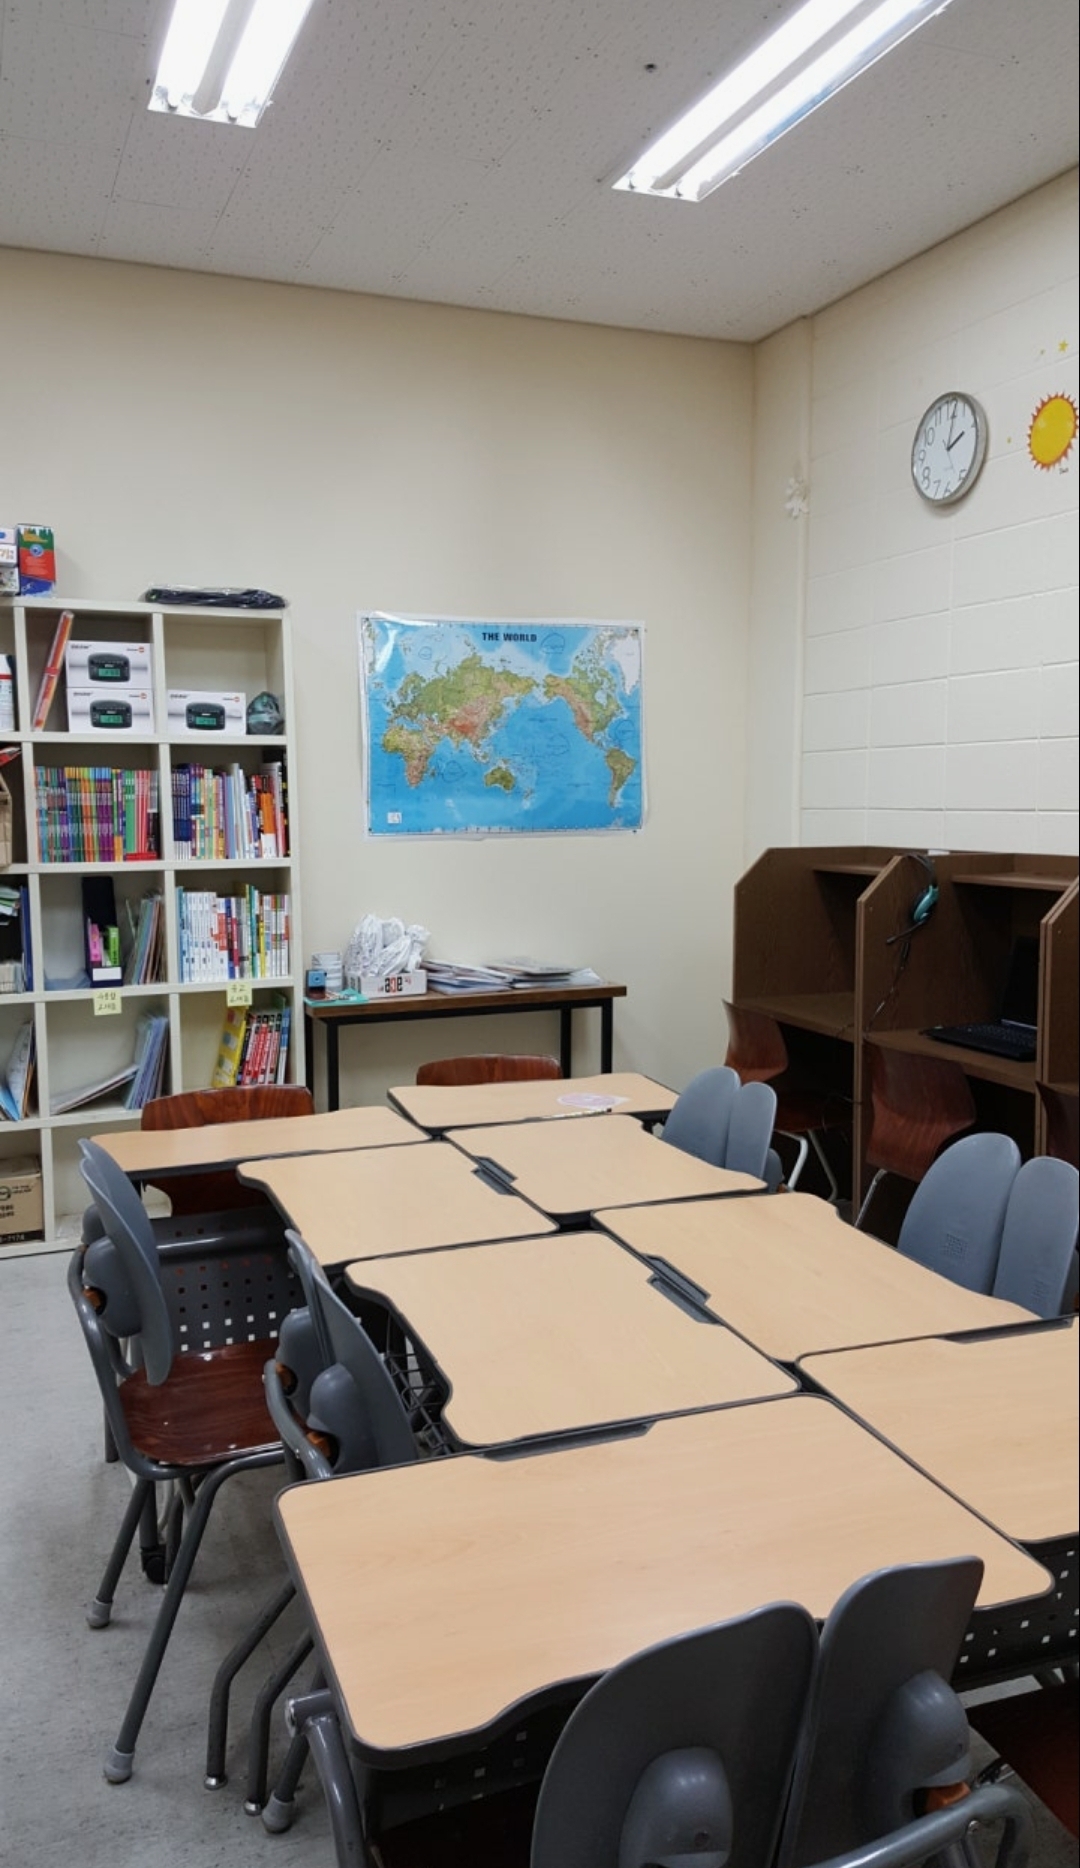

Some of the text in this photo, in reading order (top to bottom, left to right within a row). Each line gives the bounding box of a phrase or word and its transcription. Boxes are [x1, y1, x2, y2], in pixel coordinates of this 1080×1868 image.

[935, 407, 942, 427] 11
[946, 399, 958, 419] 12
[924, 427, 935, 447] 10
[918, 450, 927, 466] 9
[922, 467, 931, 490] 8
[933, 480, 941, 499] 7
[482, 632, 537, 642] THE WORLD
